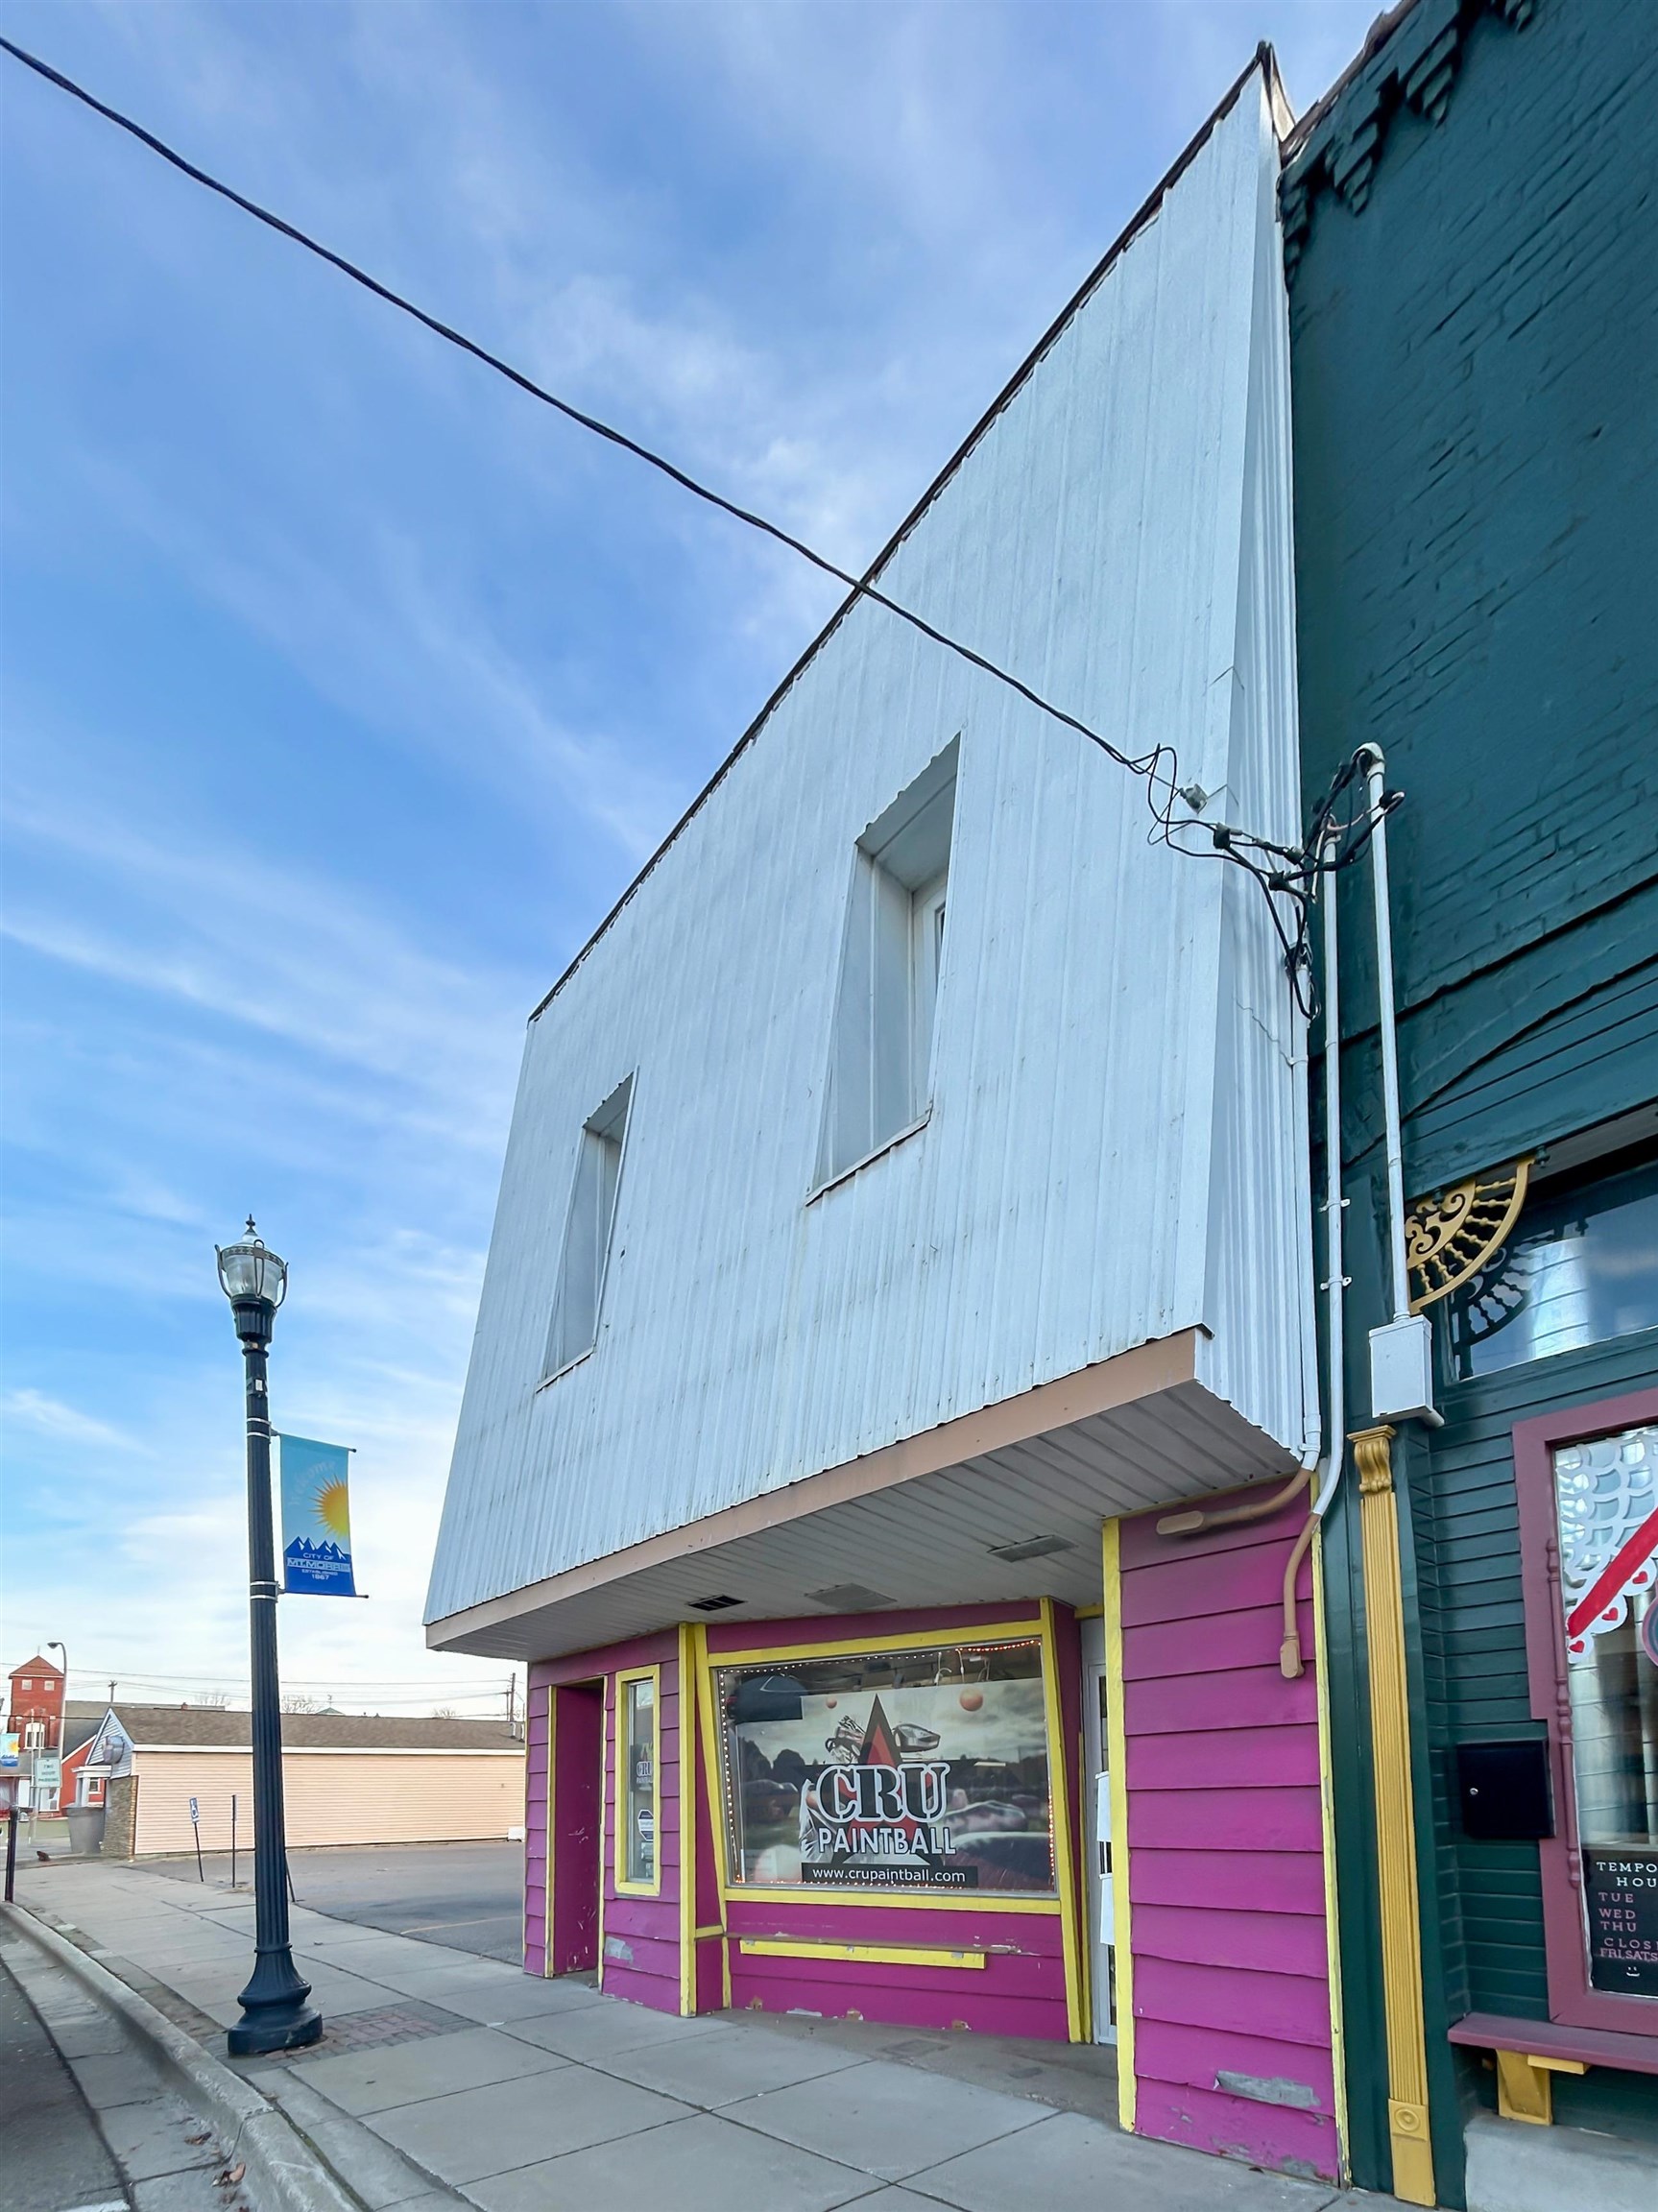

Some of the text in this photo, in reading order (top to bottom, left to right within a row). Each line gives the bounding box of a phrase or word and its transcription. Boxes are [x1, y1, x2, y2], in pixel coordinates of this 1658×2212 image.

[816, 1762, 951, 1823] CRU
[818, 1826, 956, 1856] PAINTBALL
[1596, 1862, 1658, 1873] TEMPO
[812, 1867, 966, 1883] www.crupaintball.com
[1616, 1876, 1657, 1887] HOU
[1598, 1891, 1634, 1903] TUE
[1598, 1908, 1636, 1919] WED
[1599, 1920, 1637, 1932] THU
[1603, 1937, 1658, 1950] CLOS
